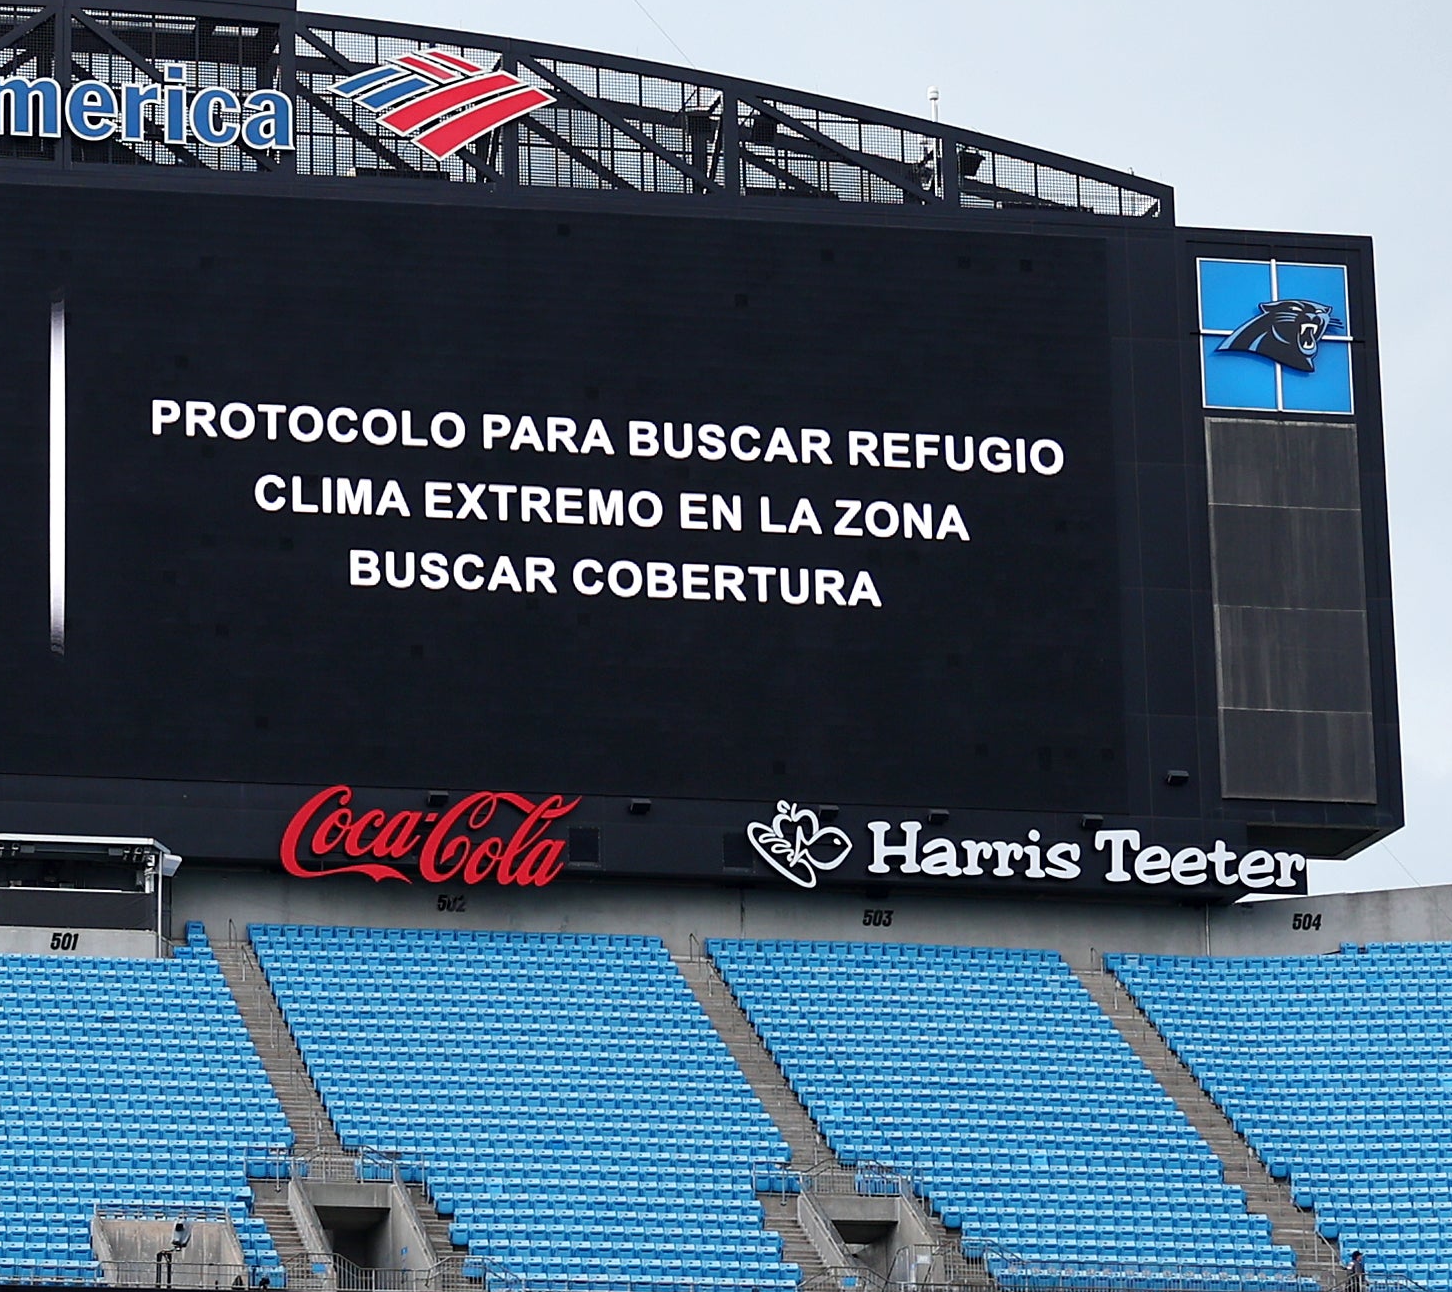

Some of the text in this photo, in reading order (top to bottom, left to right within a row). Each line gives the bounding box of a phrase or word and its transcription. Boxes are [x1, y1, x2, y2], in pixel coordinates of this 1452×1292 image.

[153, 400, 1063, 475] PROTOCOLO PARA BUSCAR REFUGIO
[255, 475, 970, 540] CLIMA EXTREMO EN LA ZONA
[350, 550, 881, 606] BUSCAR COBERTURA
[280, 785, 579, 886] Coca-Cola
[868, 821, 1306, 891] Harris Teeter
[437, 894, 469, 912] 502
[863, 909, 894, 928] 503
[1293, 913, 1321, 930] 504
[51, 933, 79, 950] 501
